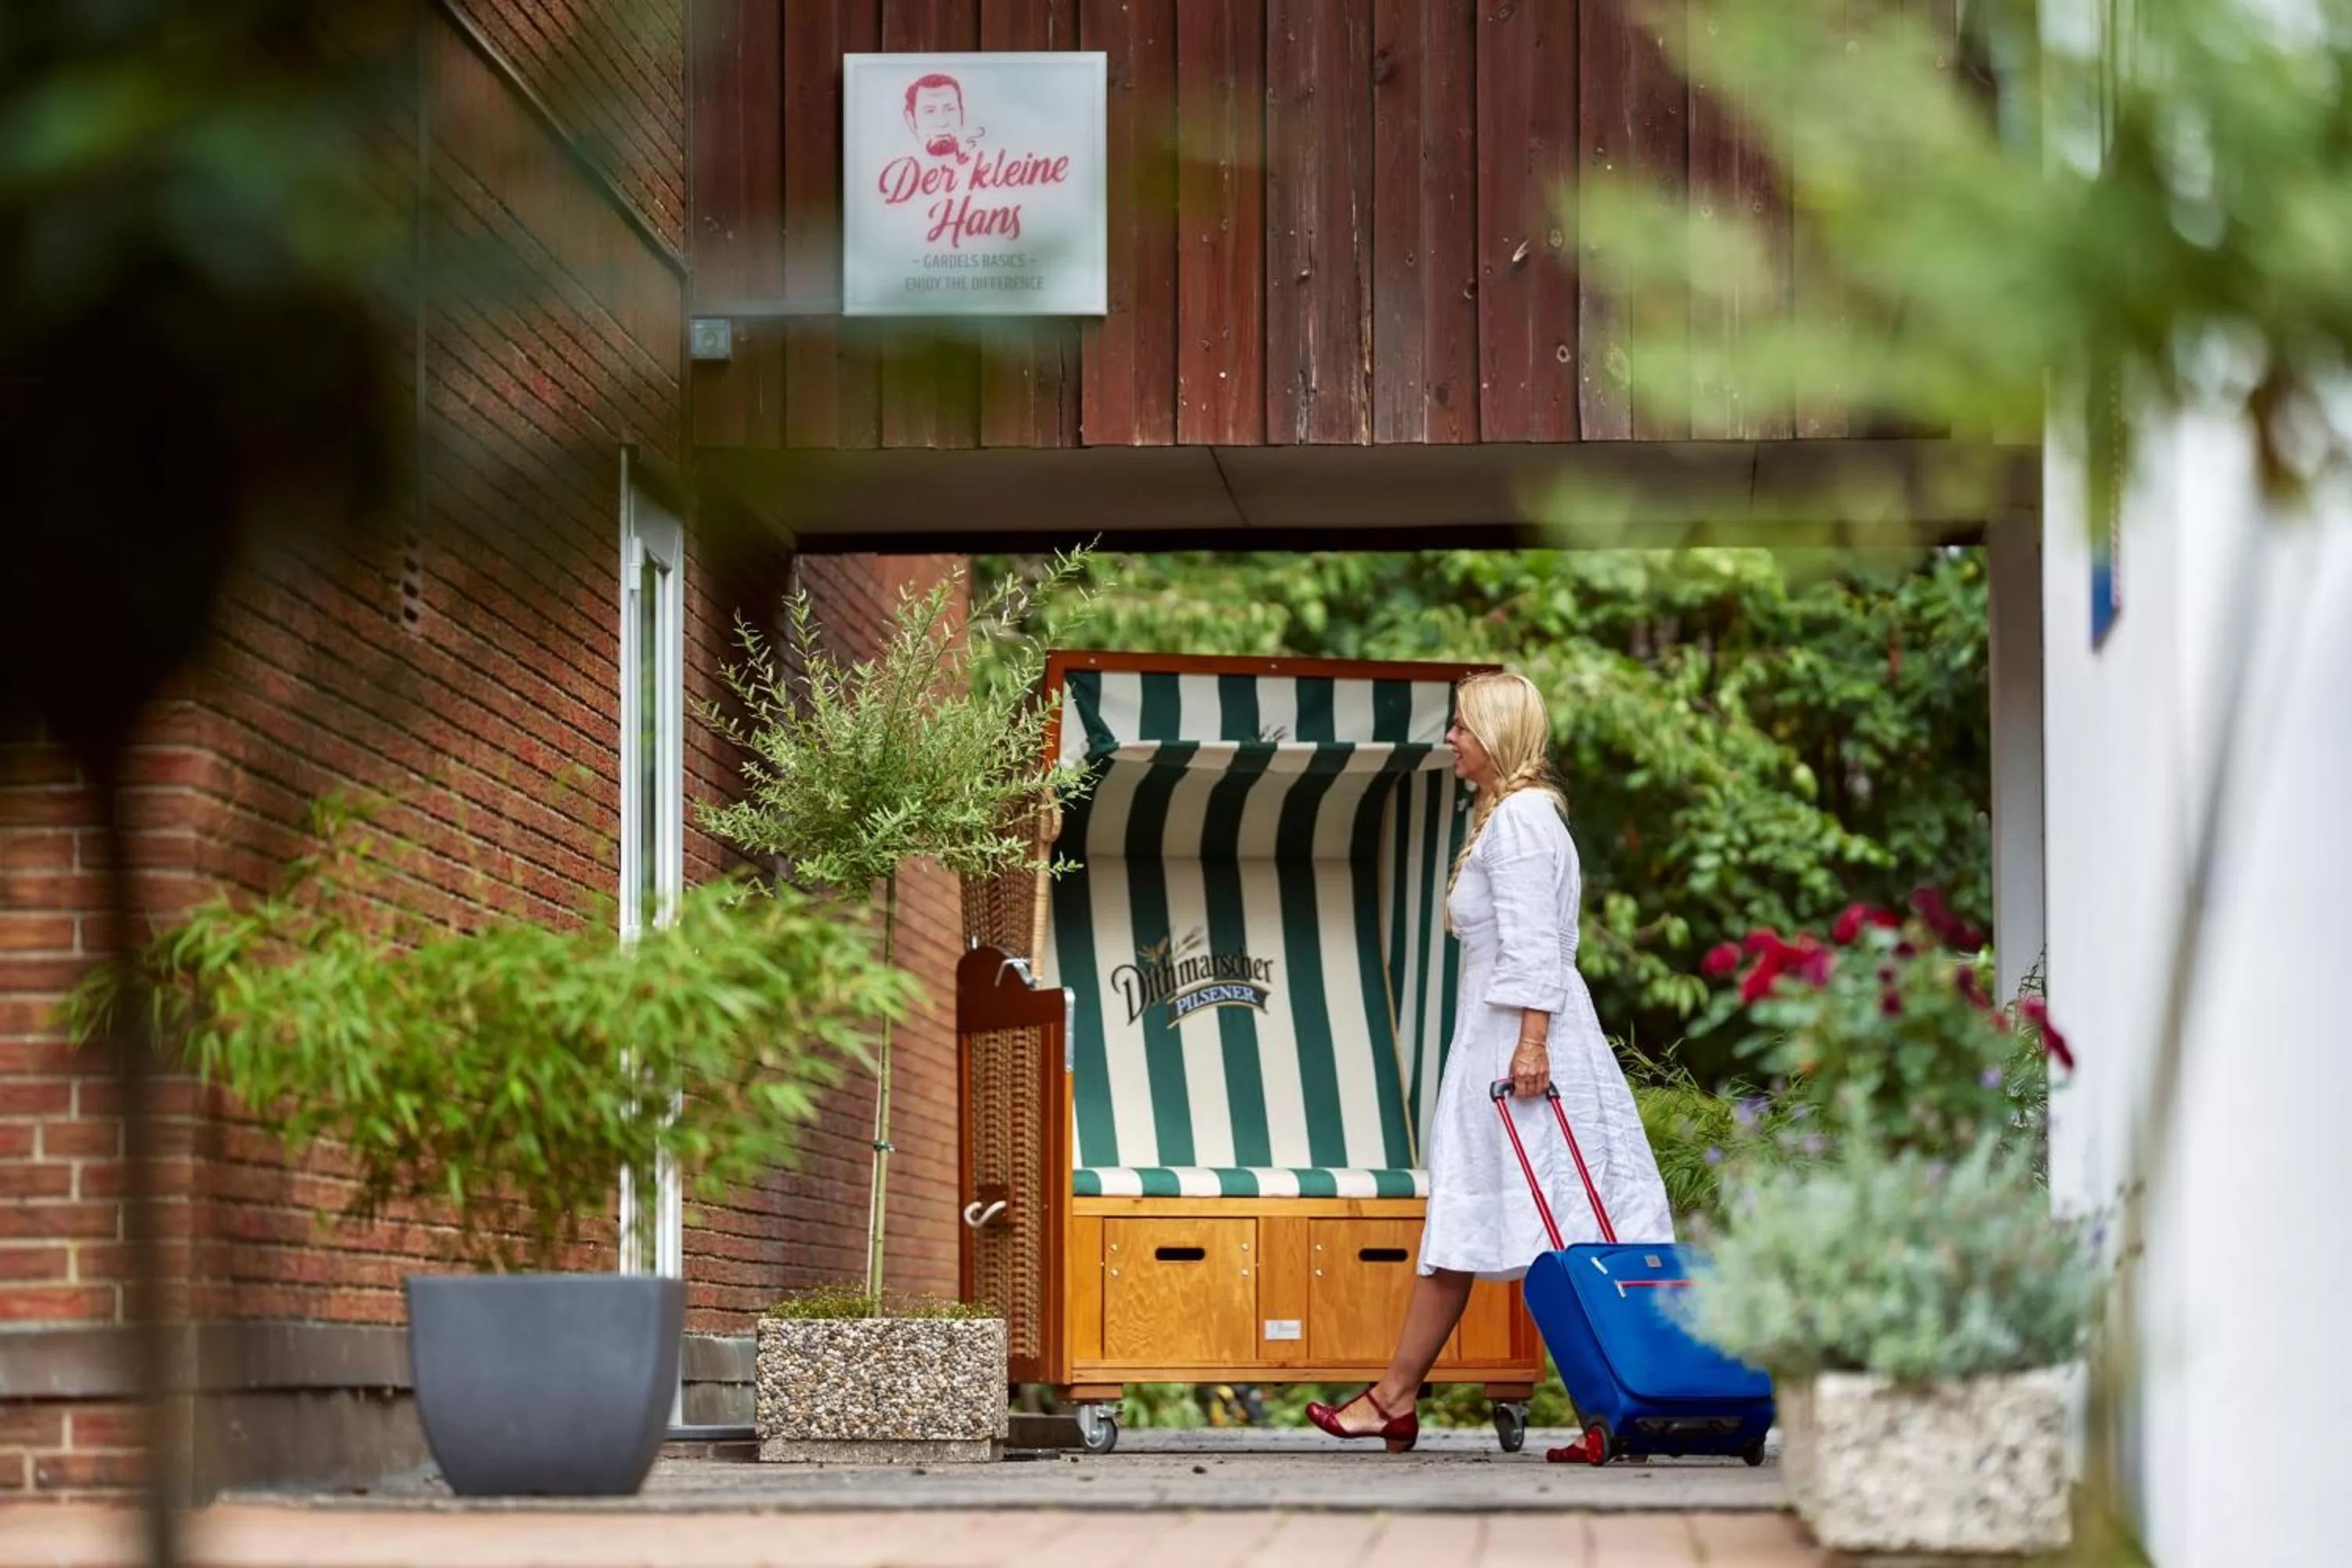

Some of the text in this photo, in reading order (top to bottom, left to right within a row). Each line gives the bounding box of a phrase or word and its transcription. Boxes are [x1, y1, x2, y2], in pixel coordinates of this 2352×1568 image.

[878, 148, 1069, 204] Der kleine
[927, 195, 1022, 249] Hans
[923, 252, 1026, 268] GARDELS BASICS
[905, 275, 1045, 291] ENJOY THE DIFFERENCE
[1176, 985, 1258, 1016] PILSENER
